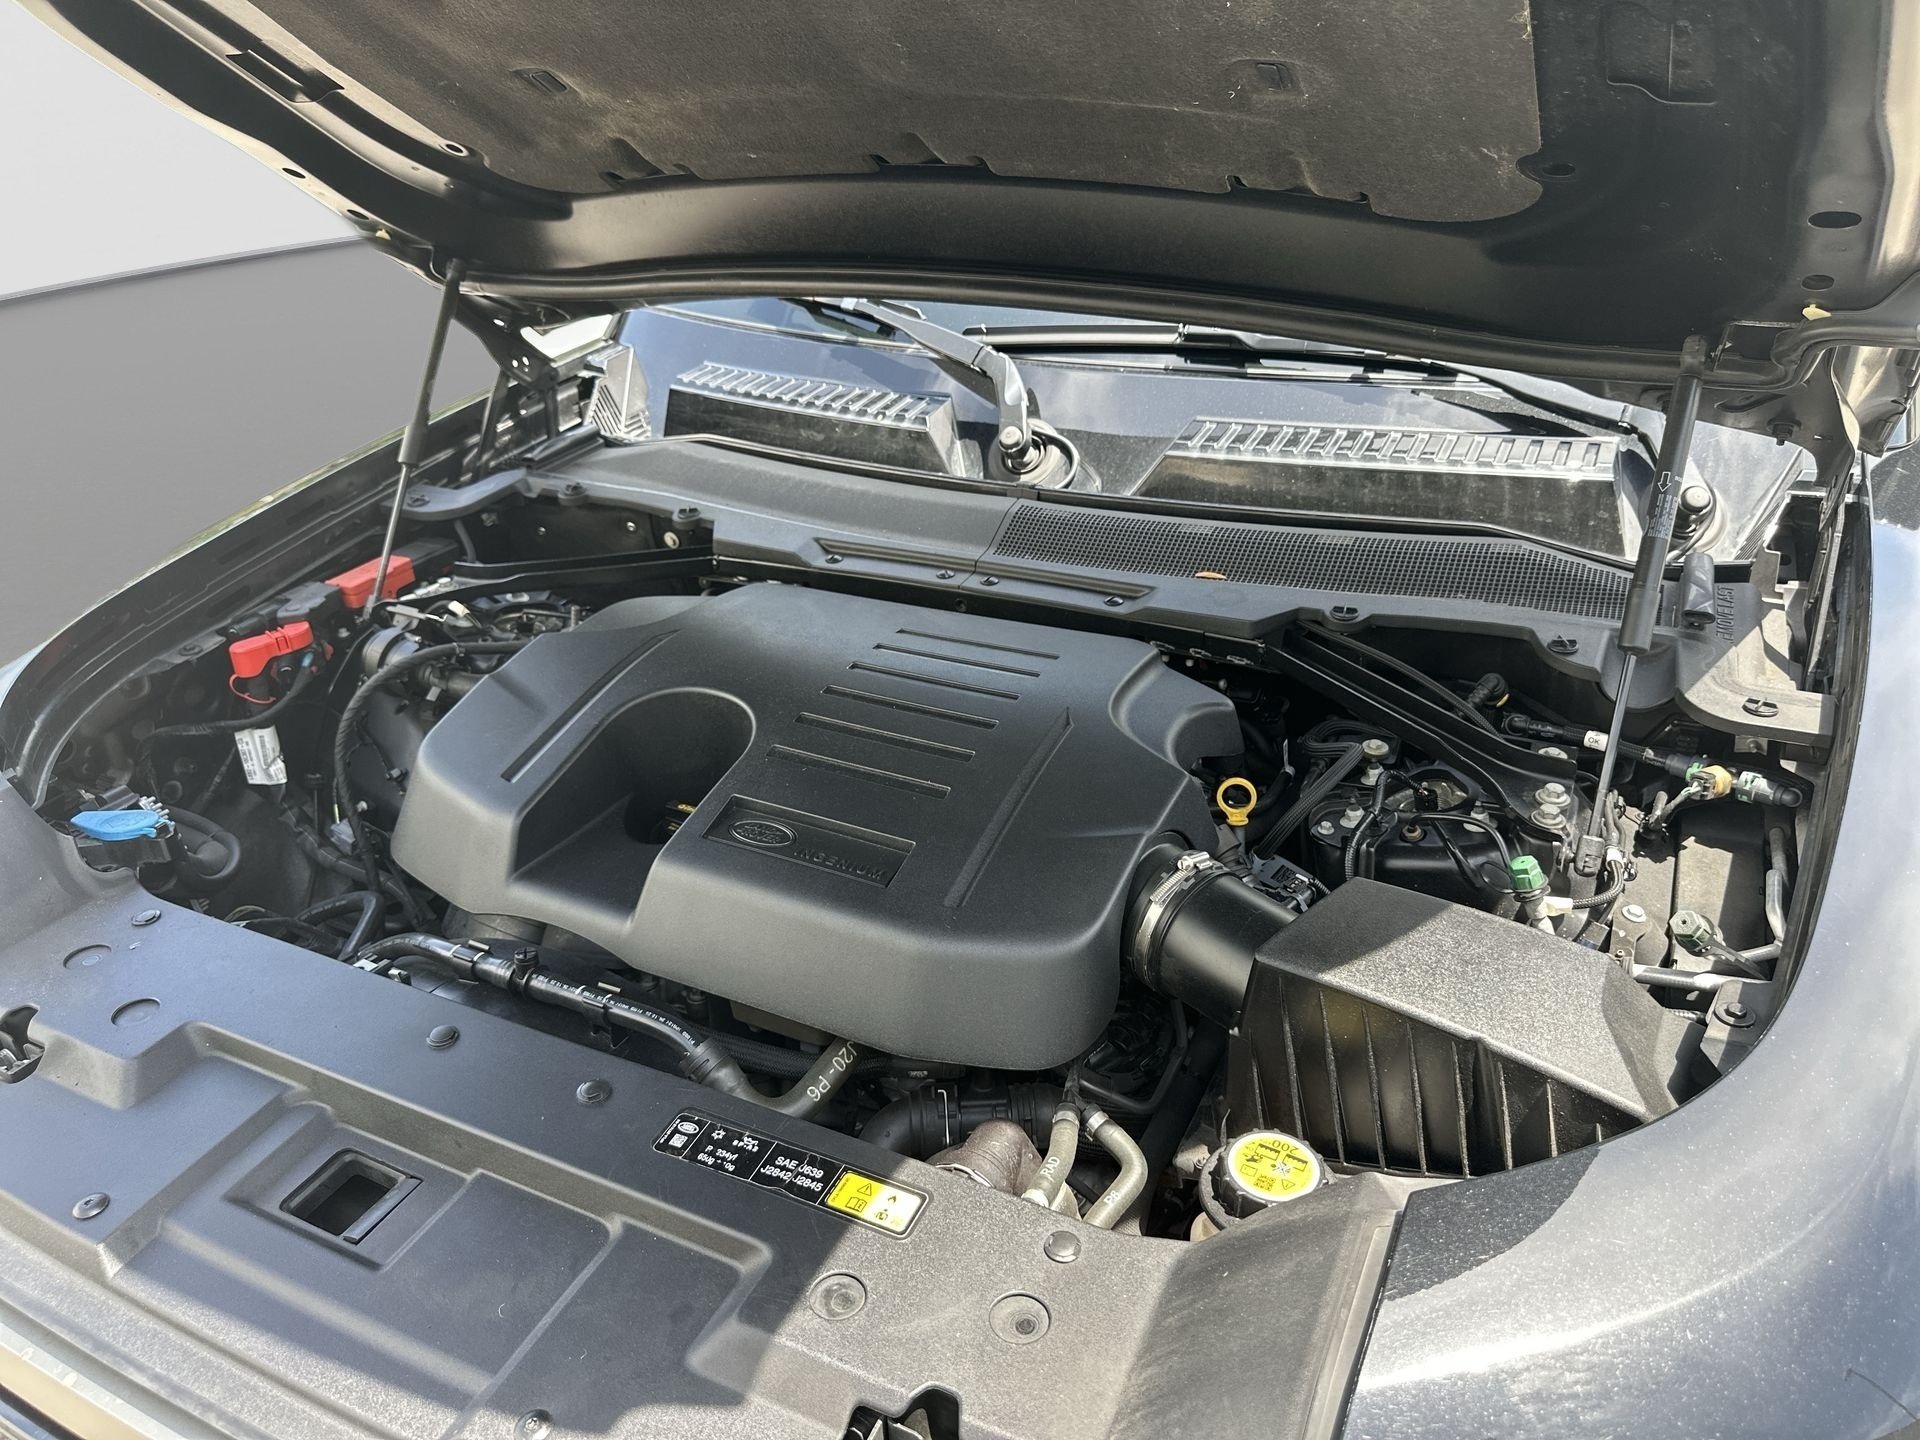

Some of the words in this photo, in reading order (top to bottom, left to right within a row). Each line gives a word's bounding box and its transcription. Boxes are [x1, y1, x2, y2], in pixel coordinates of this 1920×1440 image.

[1587, 736, 1600, 746] OK
[1271, 1139, 1300, 1155] 200
[775, 1156, 799, 1170] SAE
[798, 1164, 824, 1179] J639
